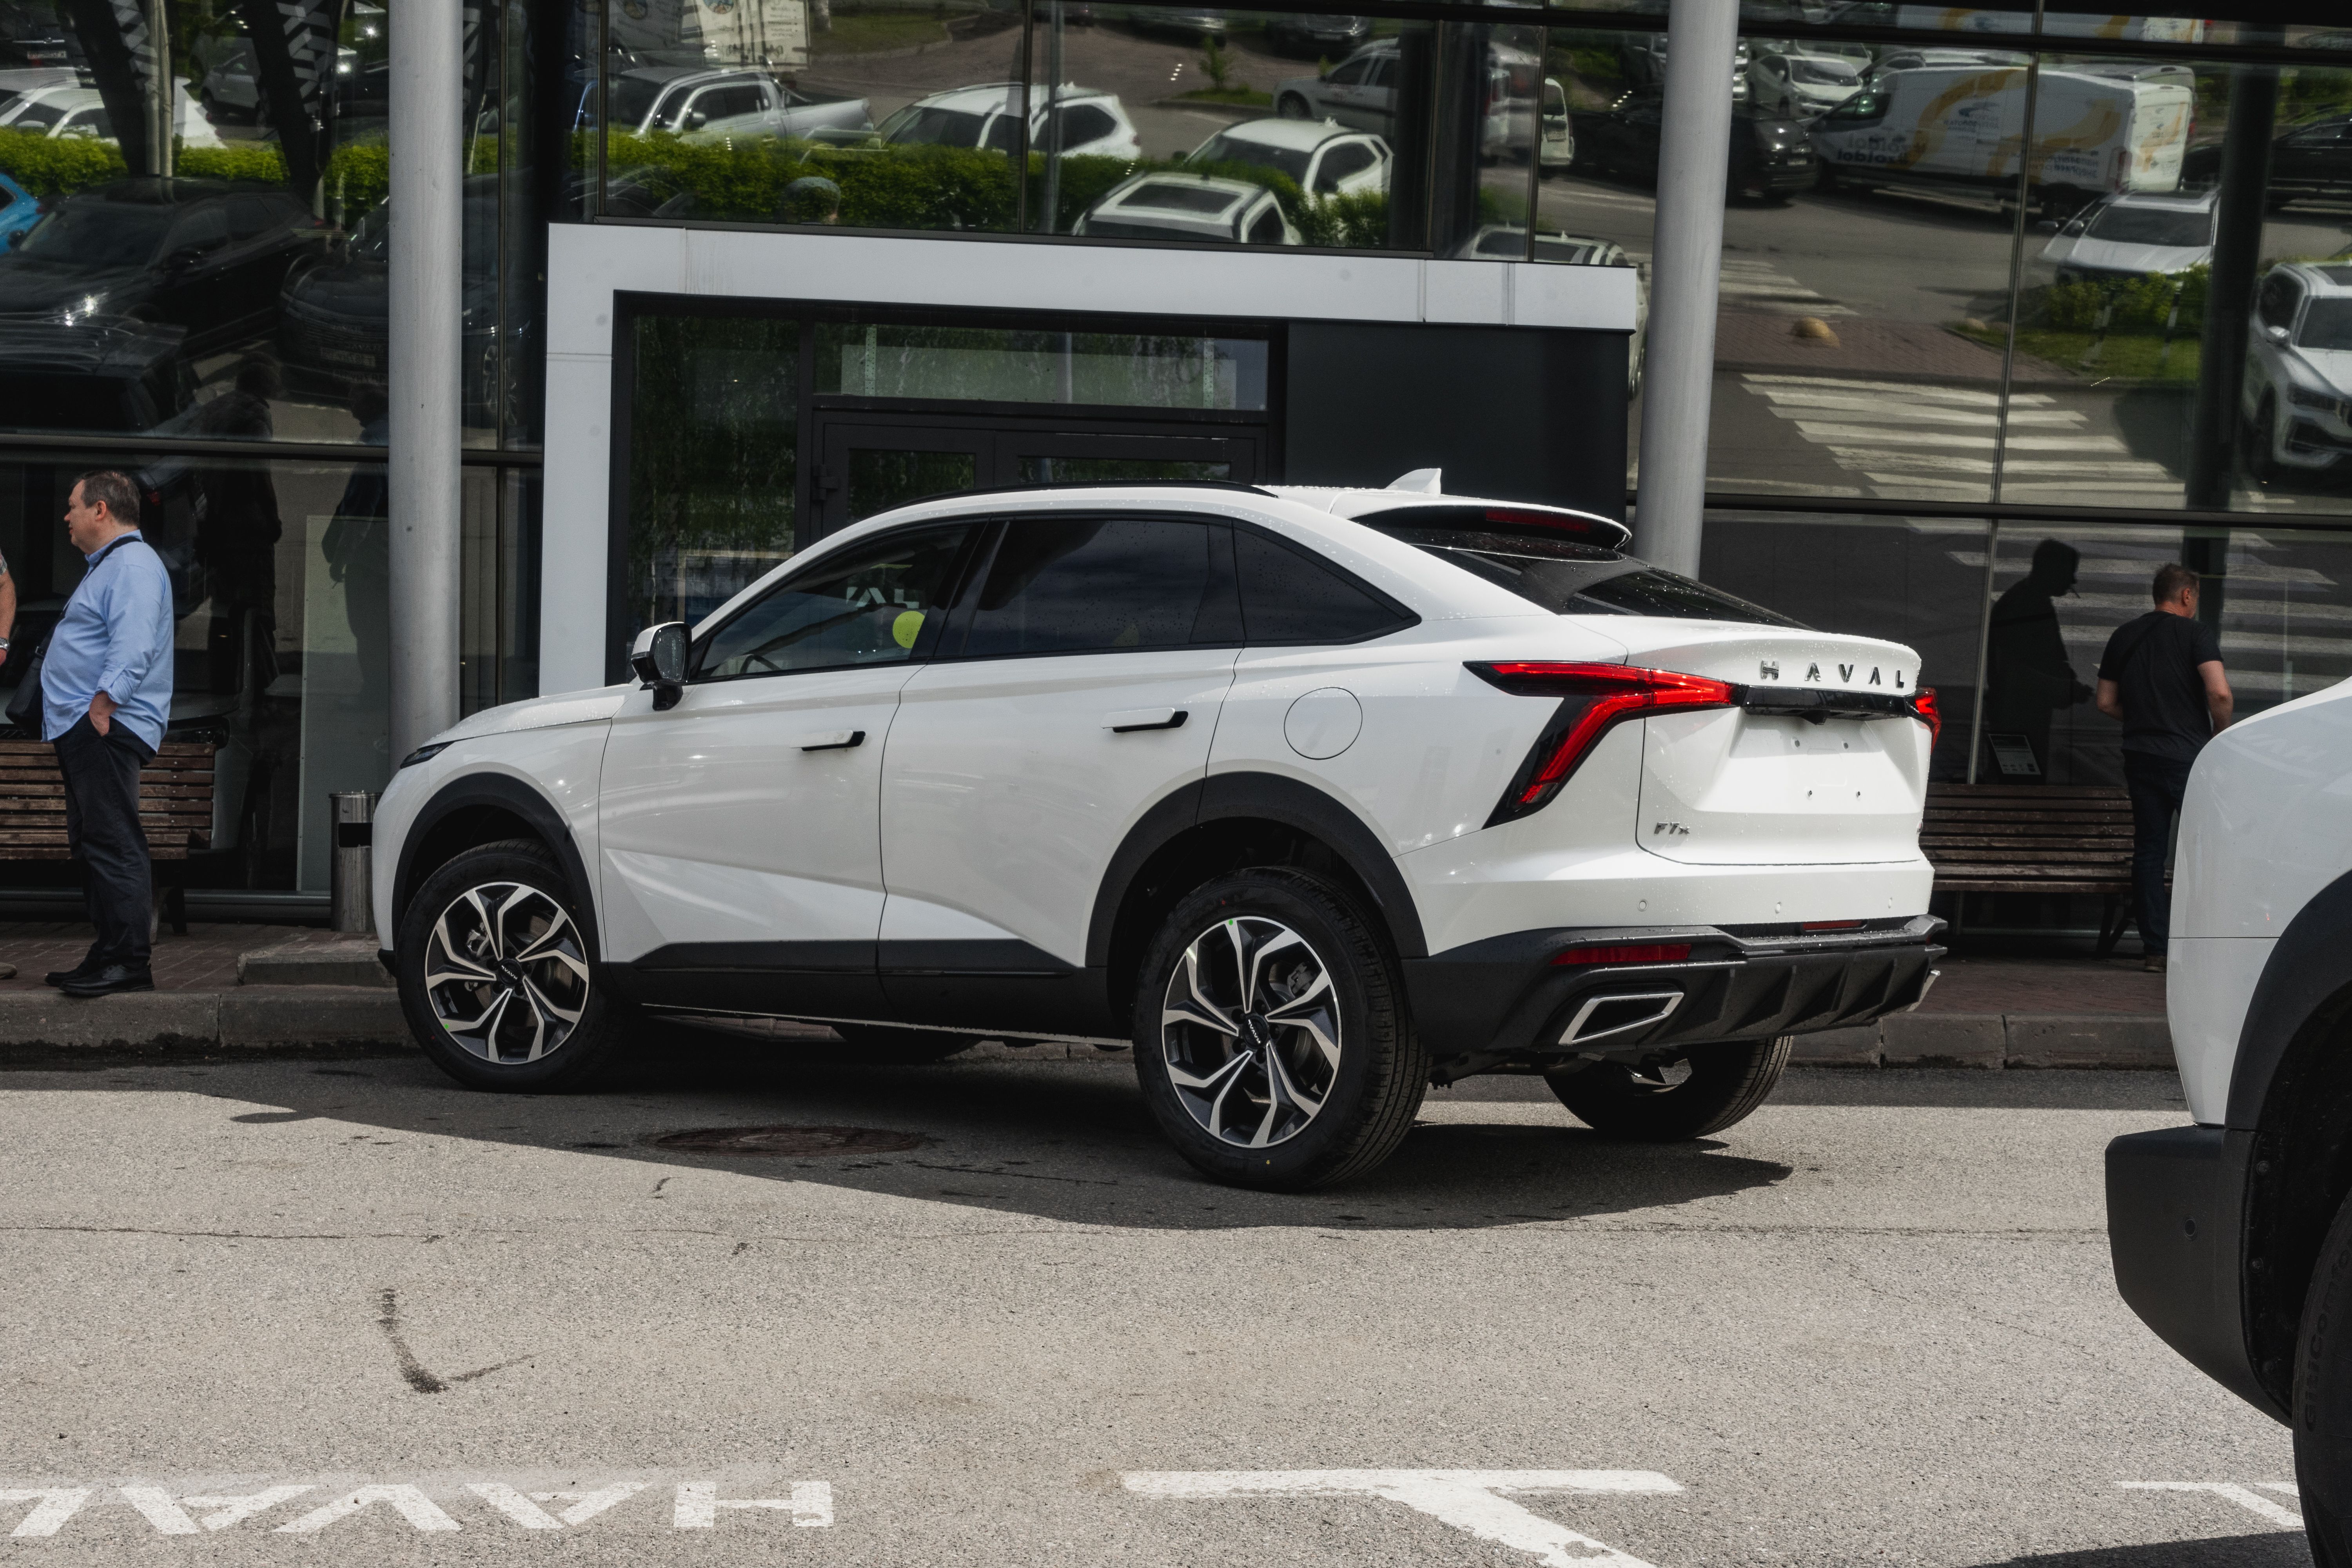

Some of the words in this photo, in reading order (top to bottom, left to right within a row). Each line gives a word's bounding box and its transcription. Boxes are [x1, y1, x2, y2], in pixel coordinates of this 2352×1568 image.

[1760, 660, 1904, 688] HAVAL
[1653, 822, 1690, 836] F7x
[501, 965, 518, 980] HAVAL
[1248, 1019, 1261, 1044] HAVAL
